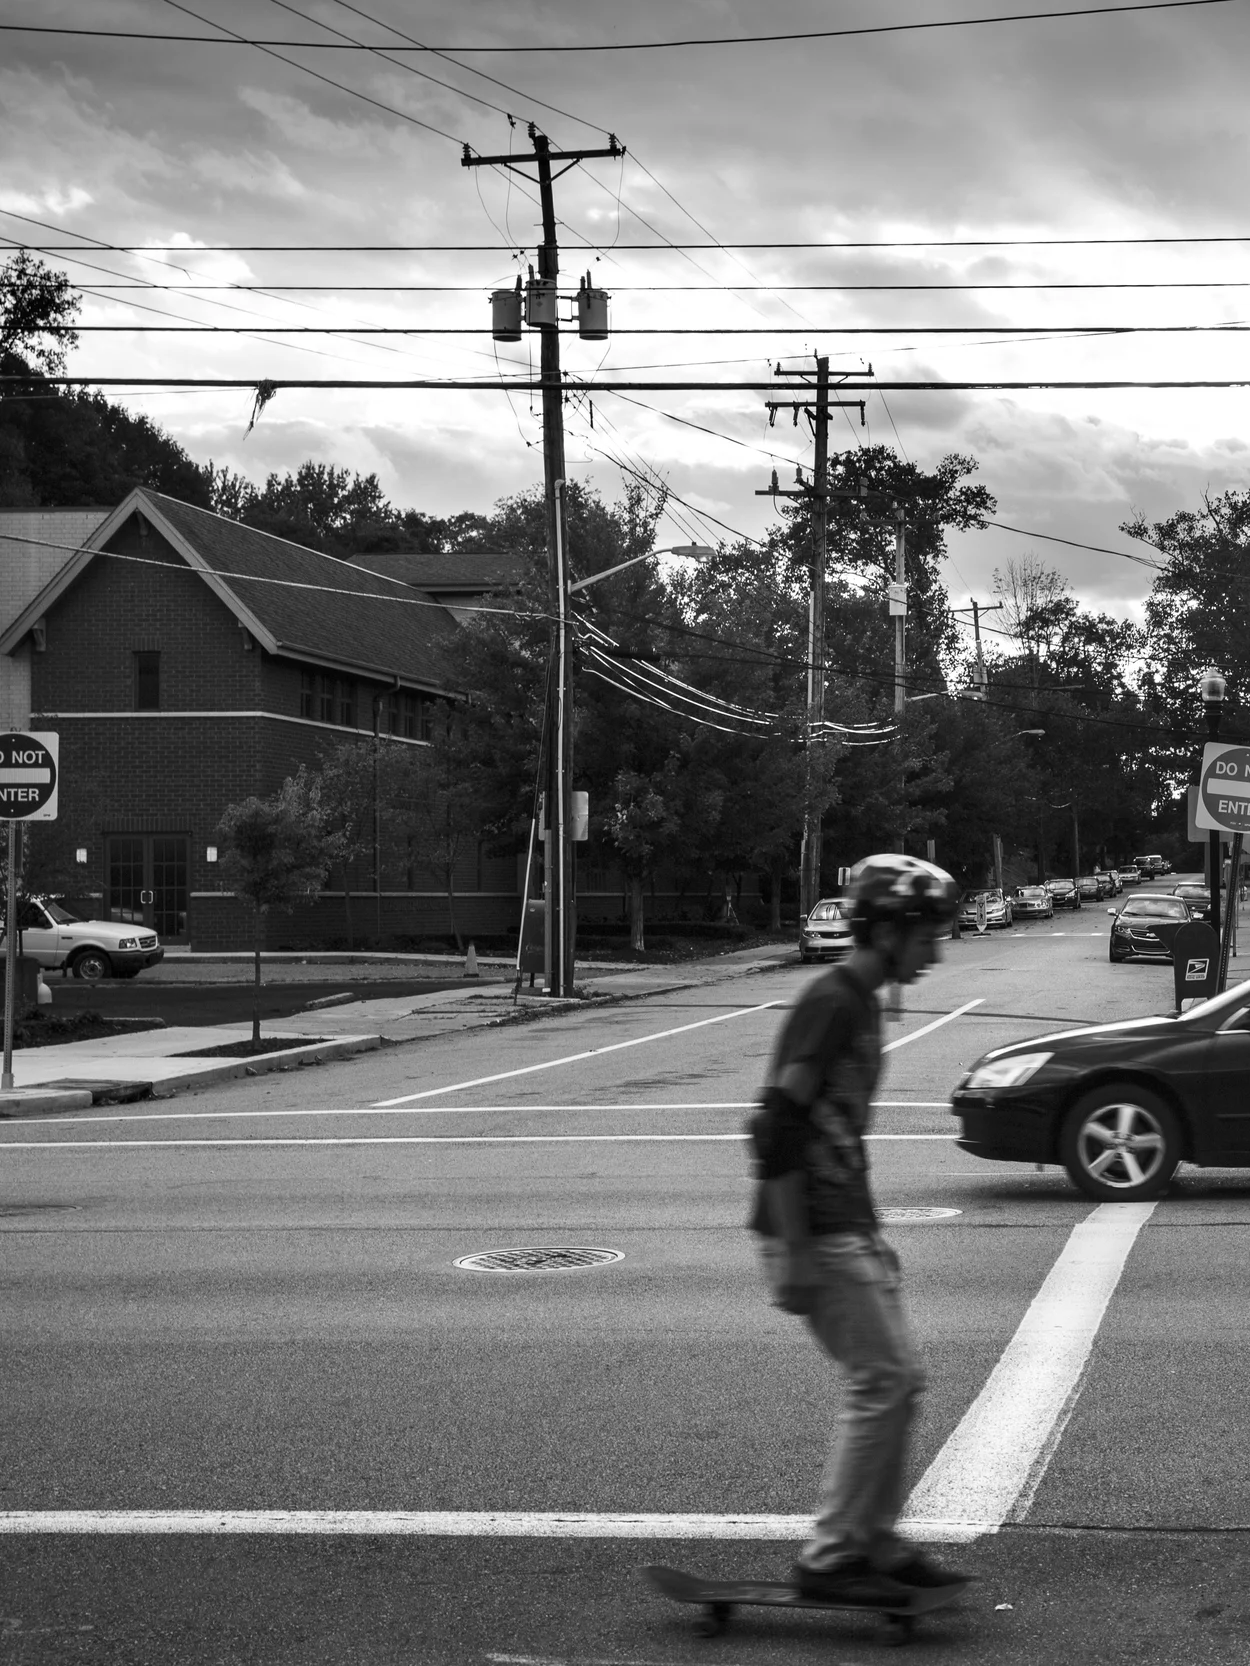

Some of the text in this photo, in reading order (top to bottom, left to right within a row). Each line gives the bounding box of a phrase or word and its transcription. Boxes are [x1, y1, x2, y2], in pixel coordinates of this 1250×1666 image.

[12, 750, 45, 764] NOT
[1216, 761, 1238, 775] DO
[0, 788, 39, 801] NTER
